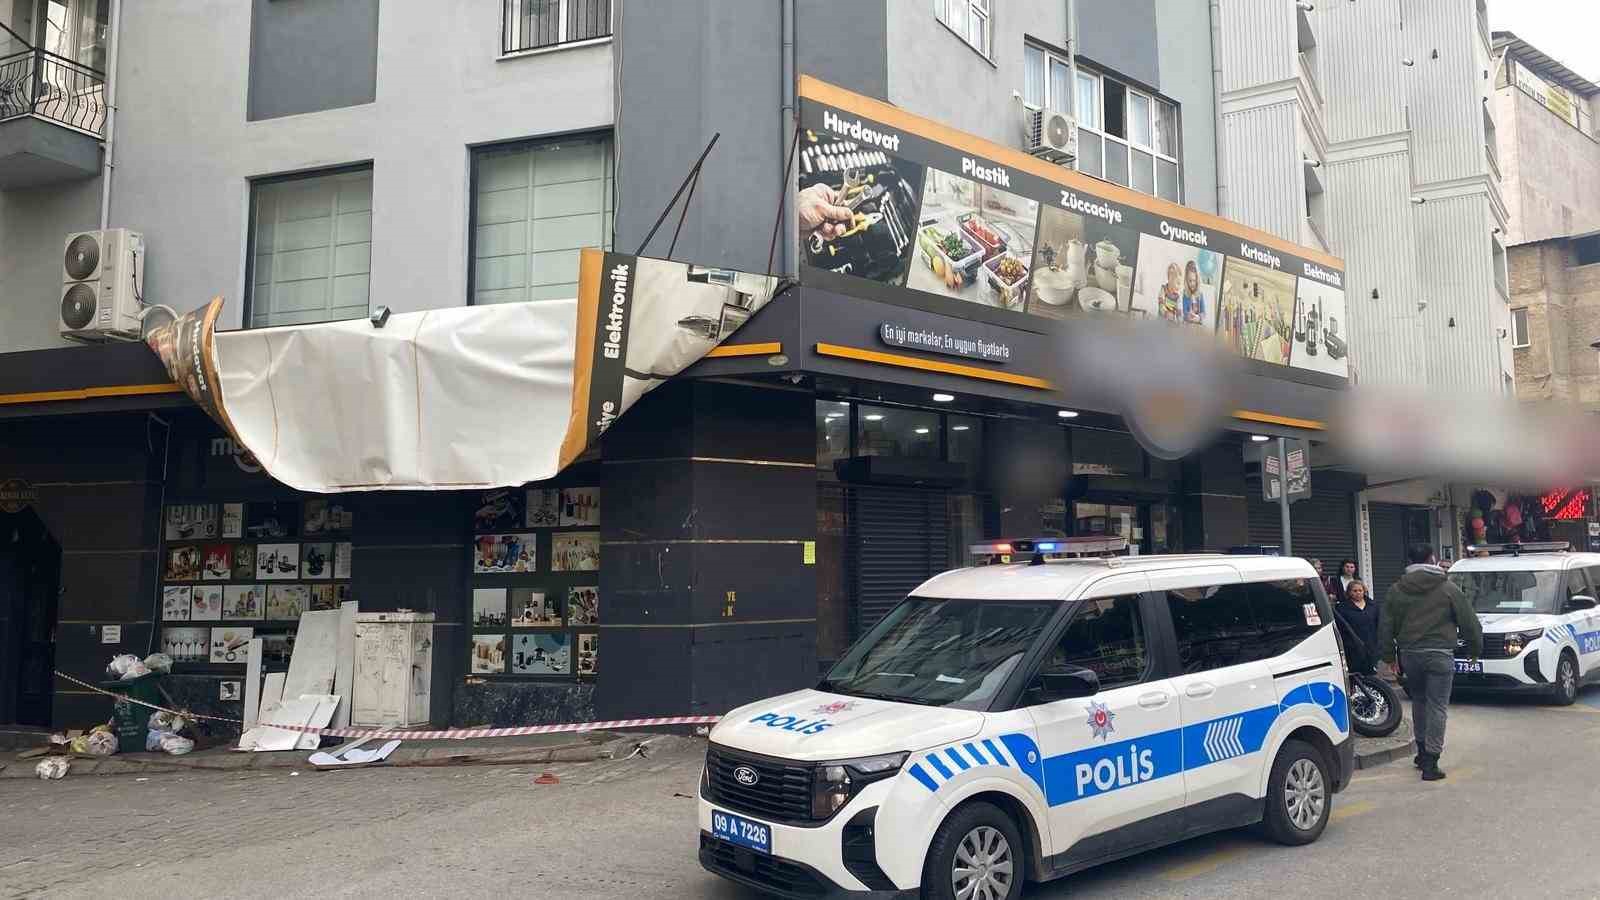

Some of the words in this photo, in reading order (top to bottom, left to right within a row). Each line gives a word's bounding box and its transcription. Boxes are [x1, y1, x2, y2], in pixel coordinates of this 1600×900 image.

[823, 110, 900, 151] Hırdavat
[961, 157, 1010, 188] Plastik
[1060, 190, 1122, 224] Züccaciye
[1160, 220, 1208, 246] Oyuncak
[1240, 243, 1281, 269] Kırtasiye
[1303, 263, 1341, 286] Elektronik
[604, 263, 629, 359] Elektronik
[884, 324, 894, 339] En
[944, 334, 953, 349] En
[954, 339, 977, 354] uygun
[977, 339, 1010, 358] fiyatlarla
[749, 711, 833, 735] POLİS
[736, 767, 754, 784] Ford
[1076, 744, 1154, 796] POLİS
[714, 813, 728, 832] 09
[730, 818, 739, 836] A
[740, 821, 767, 845] 7226
